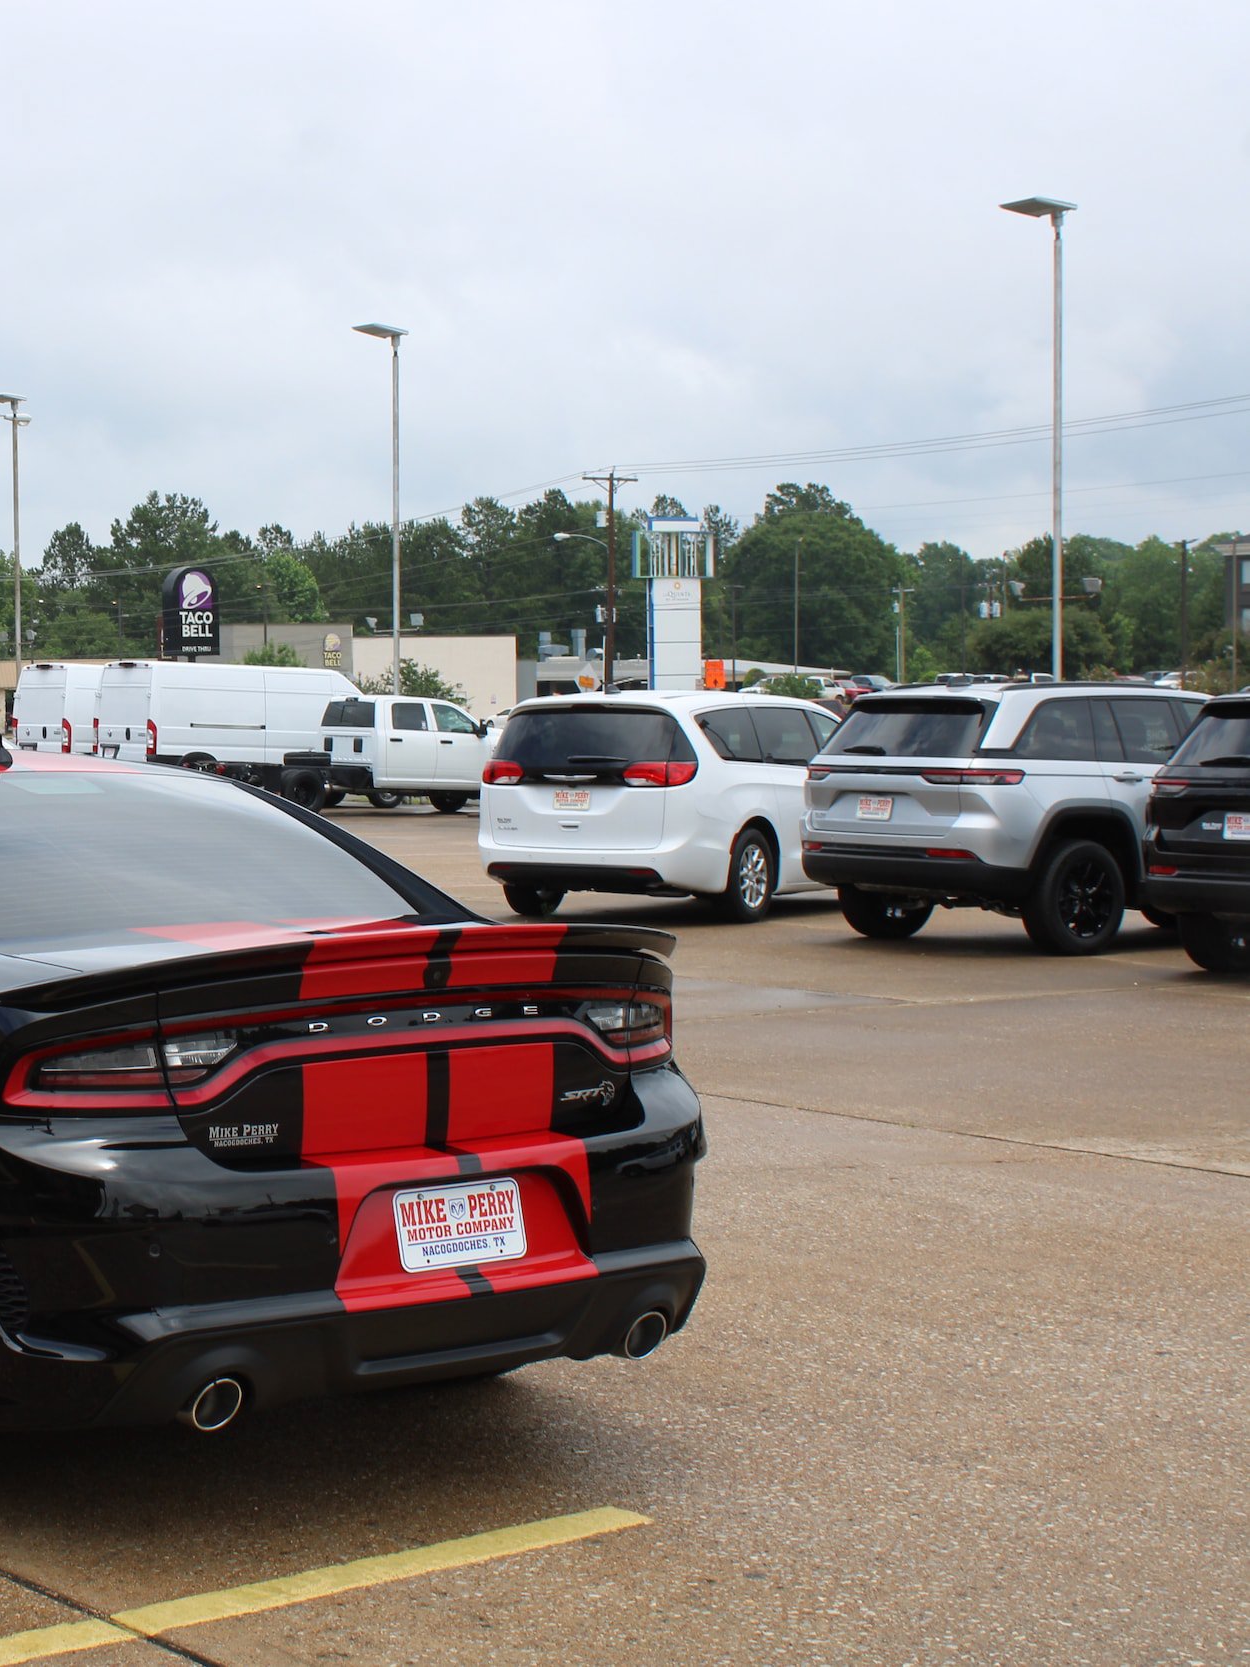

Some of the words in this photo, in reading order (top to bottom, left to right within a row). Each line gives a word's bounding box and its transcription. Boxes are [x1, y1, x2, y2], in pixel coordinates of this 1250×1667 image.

[179, 611, 214, 625] TACO
[182, 624, 214, 638] BELL
[324, 651, 342, 660] TACO
[324, 659, 341, 667] BELL
[308, 1005, 539, 1033] DODGE
[561, 1087, 603, 1102] SRT
[209, 1126, 239, 1139] MIKE
[243, 1123, 279, 1136] PERRY
[265, 1136, 274, 1144] TX
[400, 1198, 447, 1228] MIKE
[467, 1190, 515, 1219] PERRY
[407, 1224, 452, 1242] MOTOR
[456, 1216, 515, 1236] COMPANY
[493, 1236, 506, 1247] TX
